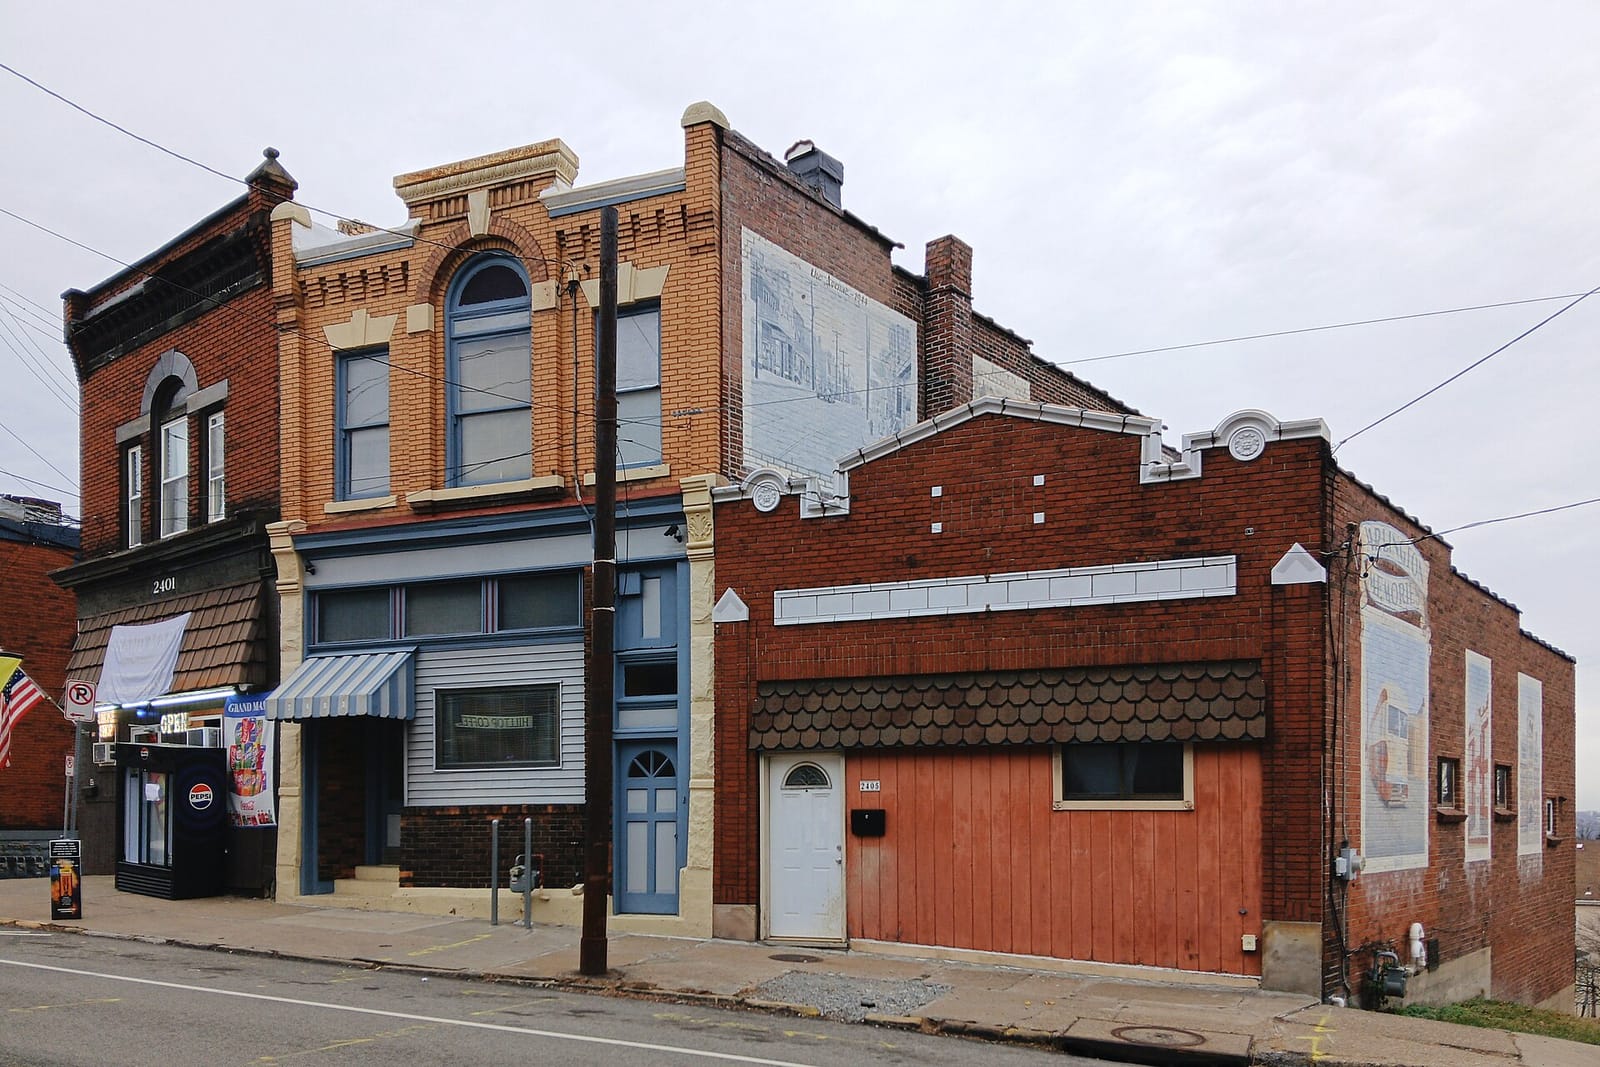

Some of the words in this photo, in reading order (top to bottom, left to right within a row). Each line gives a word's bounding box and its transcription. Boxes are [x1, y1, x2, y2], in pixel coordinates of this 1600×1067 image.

[153, 576, 175, 594] 2401
[228, 702, 252, 713] GRAND
[161, 712, 188, 734] OPEN
[860, 781, 880, 790] 2405
